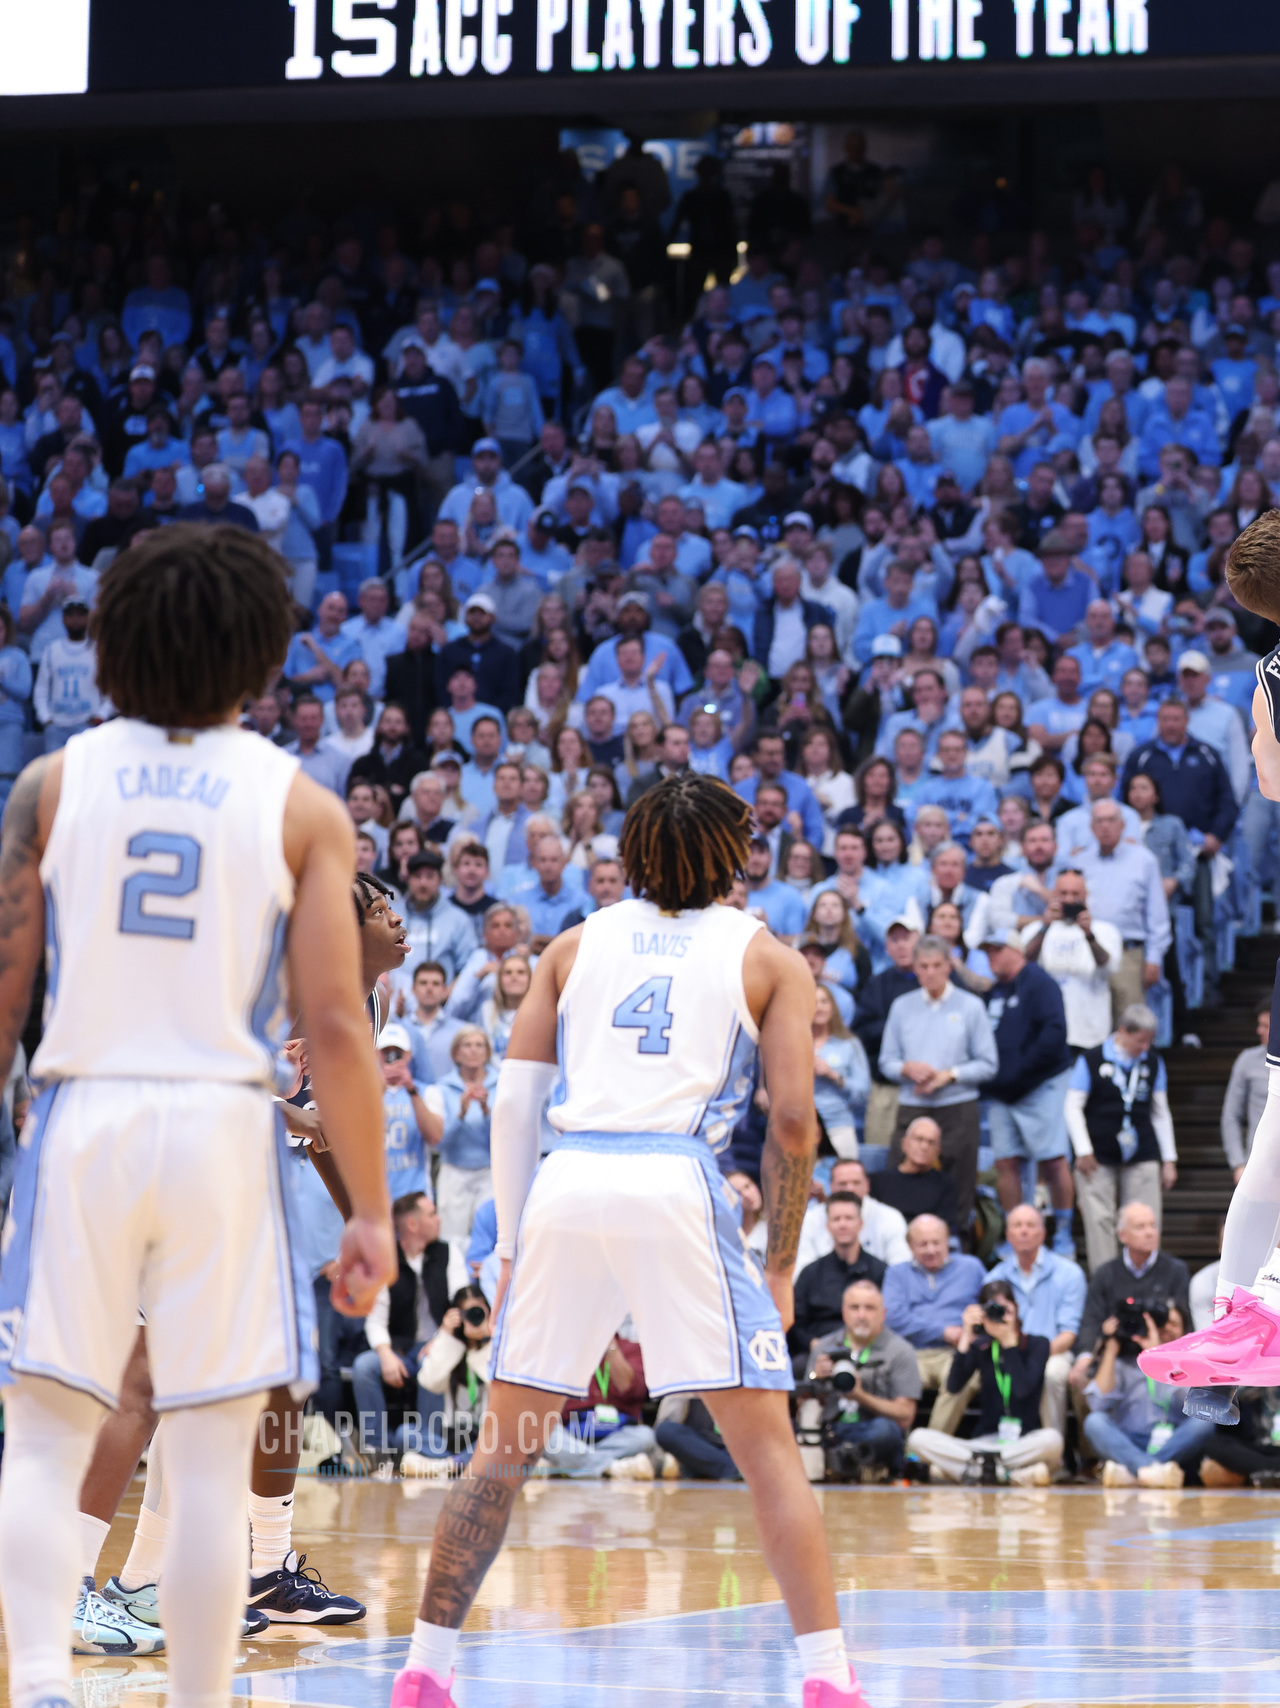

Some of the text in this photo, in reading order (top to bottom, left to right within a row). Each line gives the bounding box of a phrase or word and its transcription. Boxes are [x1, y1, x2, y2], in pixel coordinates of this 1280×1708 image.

[285, 0, 1149, 79] 15 ACC PLAYERS OF THE YEAR
[116, 763, 231, 810] CADEAU
[119, 830, 201, 940] 2
[633, 932, 693, 958] DAVIS
[612, 976, 673, 1055] 4
